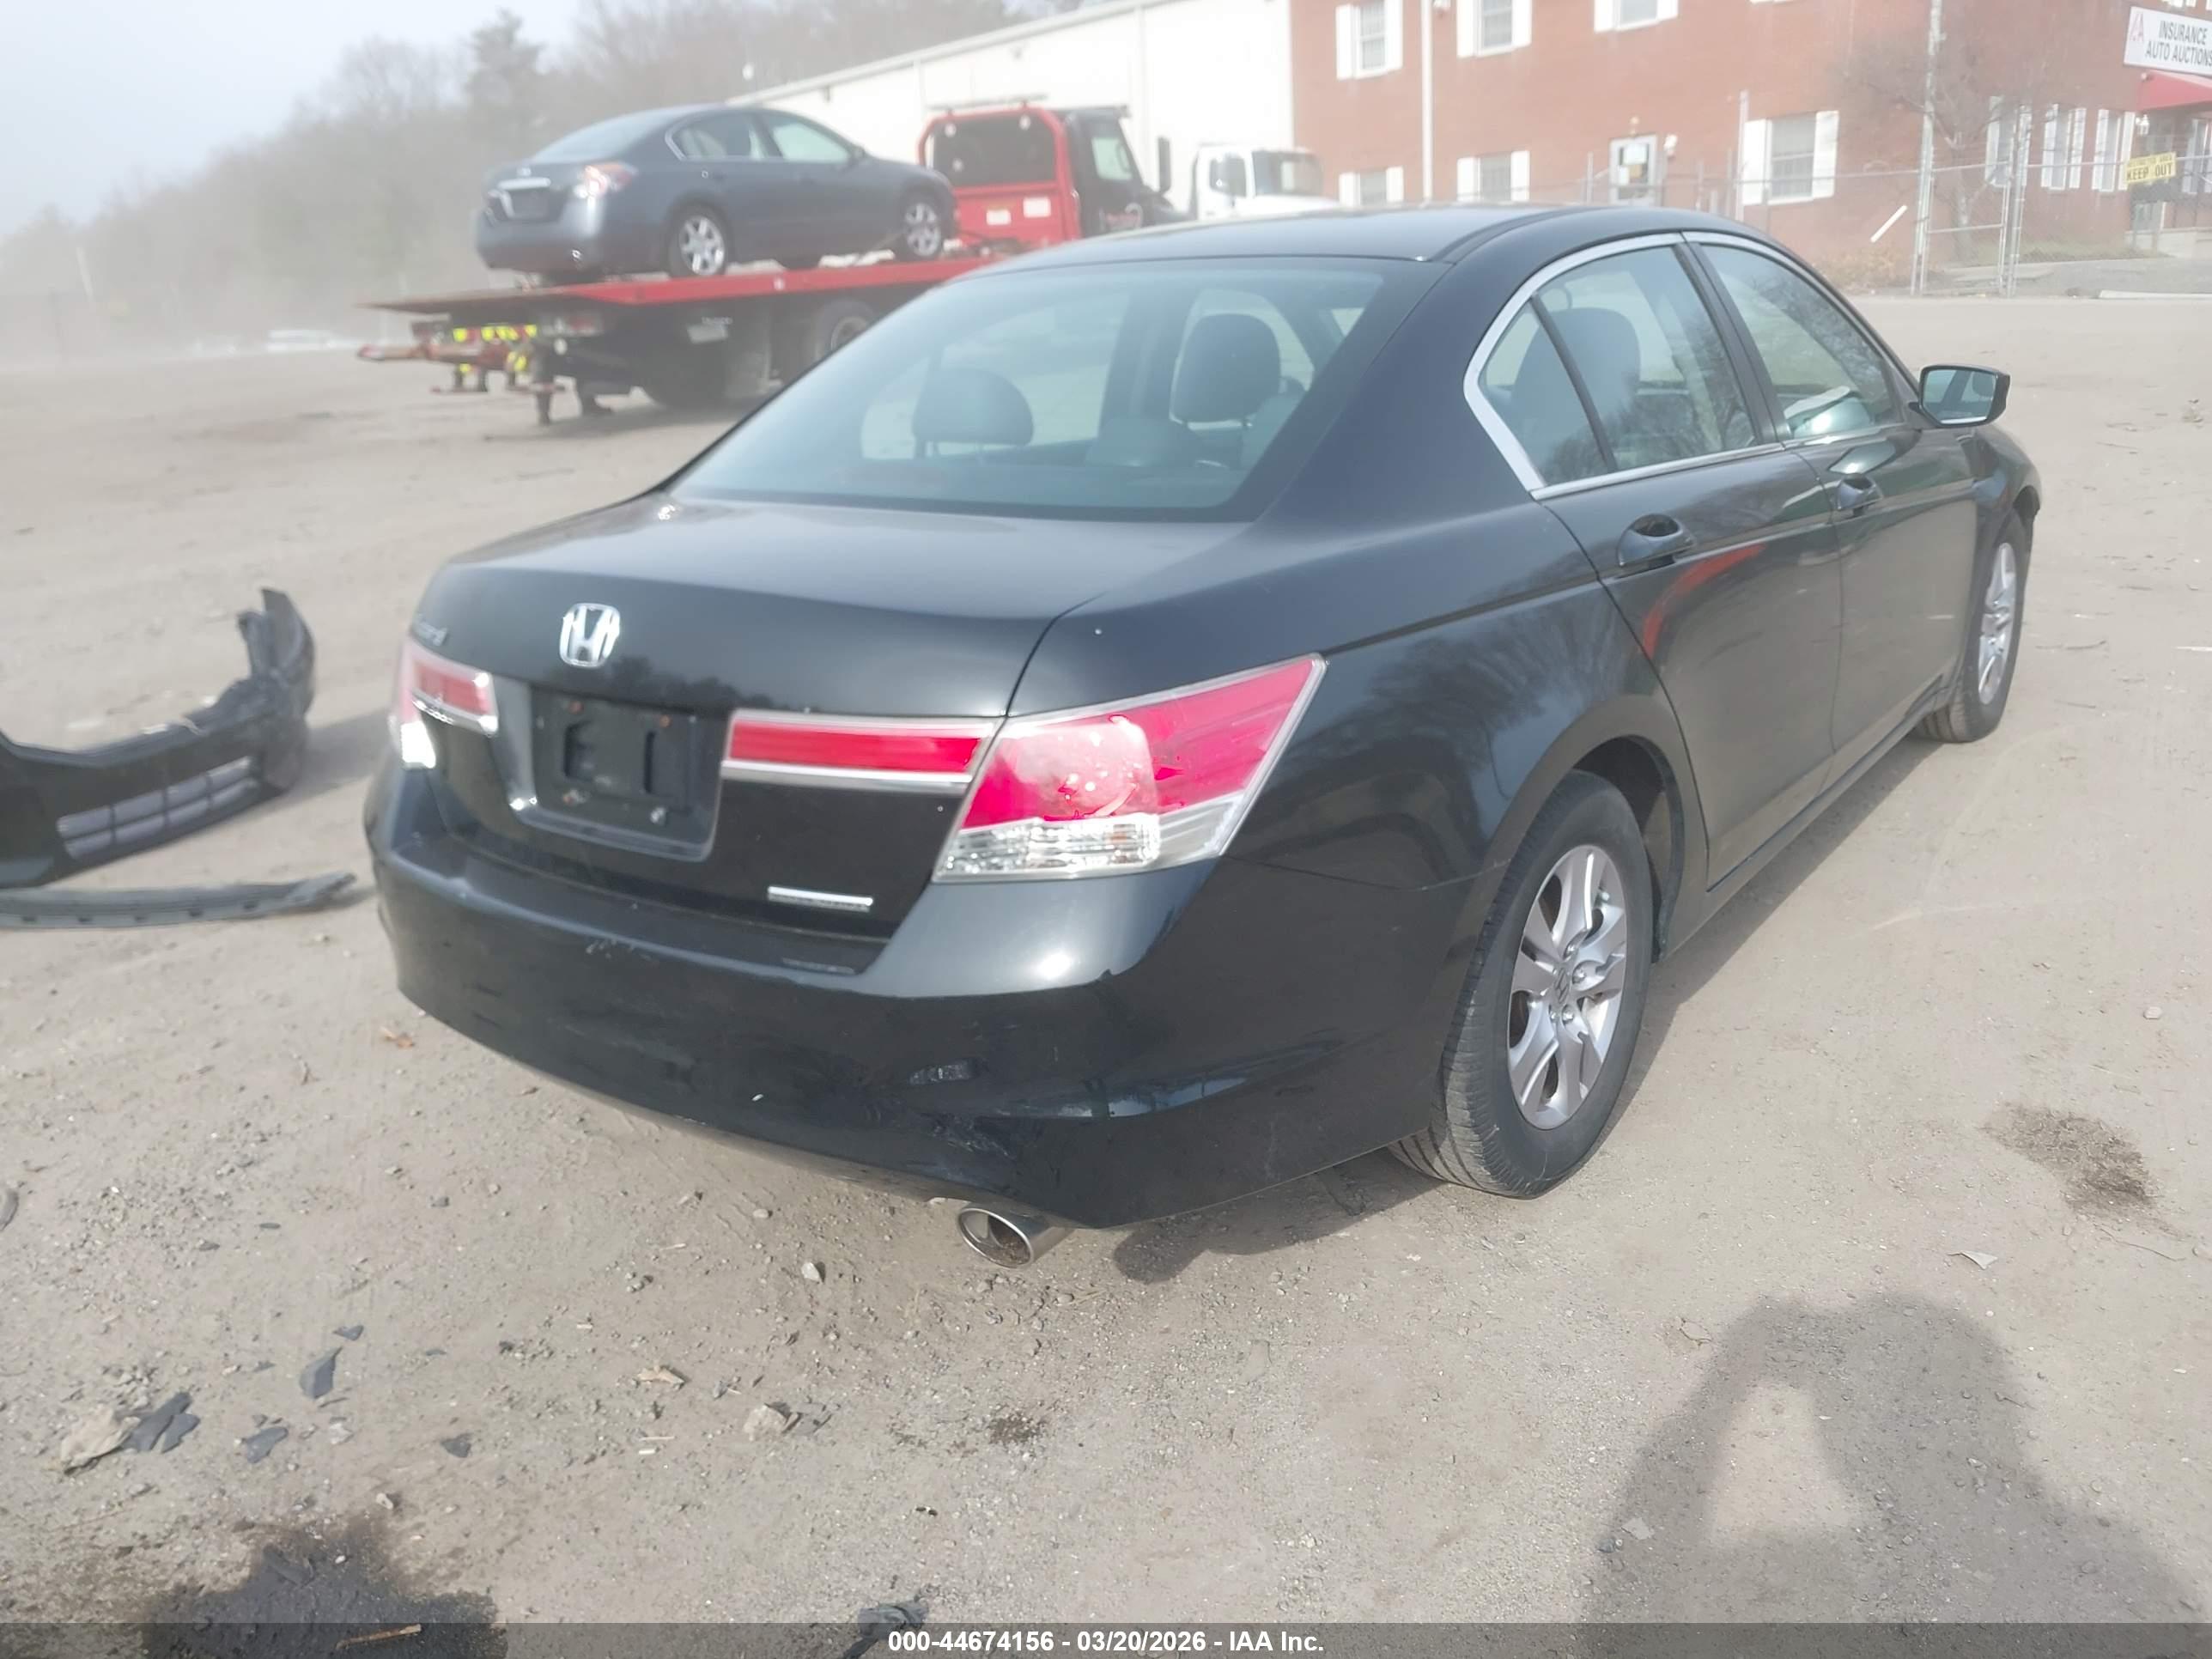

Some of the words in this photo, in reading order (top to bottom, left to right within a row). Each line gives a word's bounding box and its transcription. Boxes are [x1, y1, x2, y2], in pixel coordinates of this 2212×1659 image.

[2159, 20, 2209, 46] INSURANCE
[2144, 40, 2171, 60] AUTO
[2172, 45, 2212, 67] AUCTIONS
[2127, 166, 2148, 180] KEEP
[2154, 161, 2172, 177] OUT
